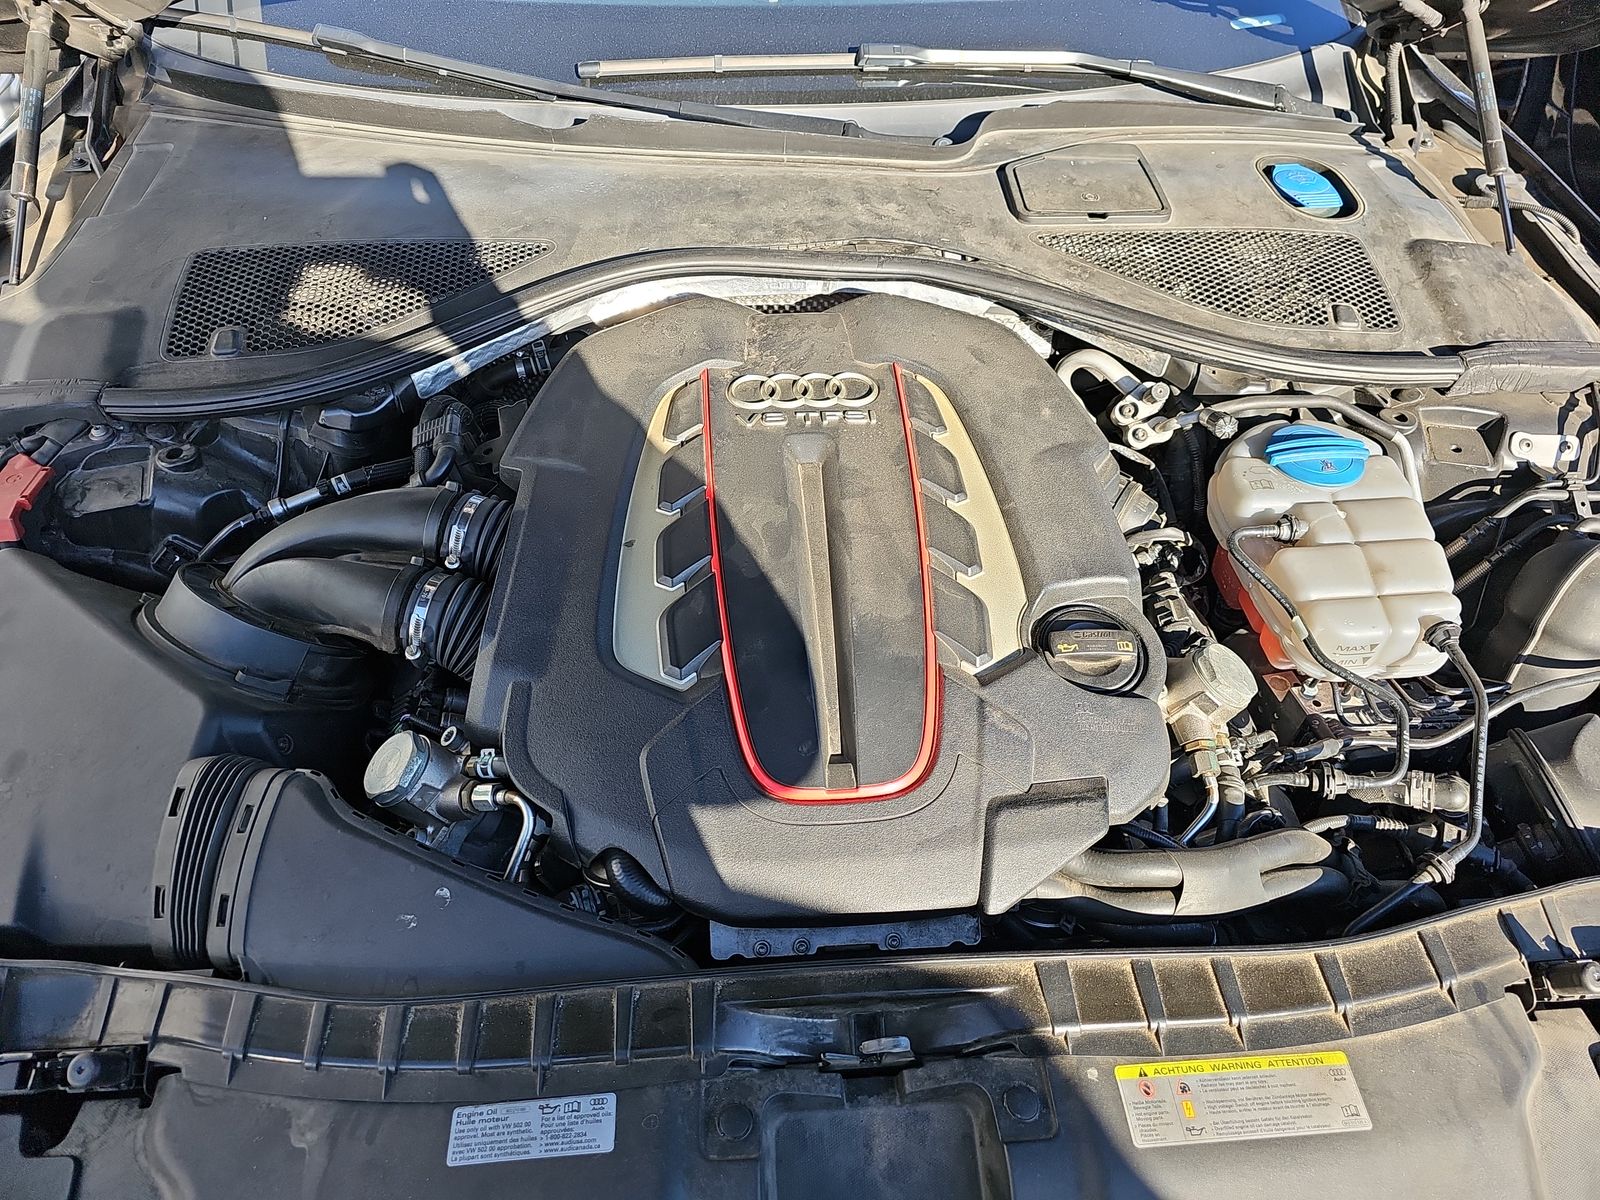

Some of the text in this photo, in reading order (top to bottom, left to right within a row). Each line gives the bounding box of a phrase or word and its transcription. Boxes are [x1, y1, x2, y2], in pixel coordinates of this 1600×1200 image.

[794, 409, 876, 426] TFSI
[1153, 1056, 1324, 1076] ACHTUNG WARNING ATTENTION
[456, 1109, 484, 1120] Engine
[478, 1115, 509, 1124] moteur
[573, 1110, 600, 1119] approved
[506, 1127, 533, 1136] synthetic.
[545, 1131, 586, 1140] 1-800-822-2834
[474, 1137, 508, 1147] uniquement
[544, 1137, 596, 1147] www.audiusa.com
[543, 1142, 600, 1153] www.audicanada.ca
[458, 1153, 479, 1162] plupart
